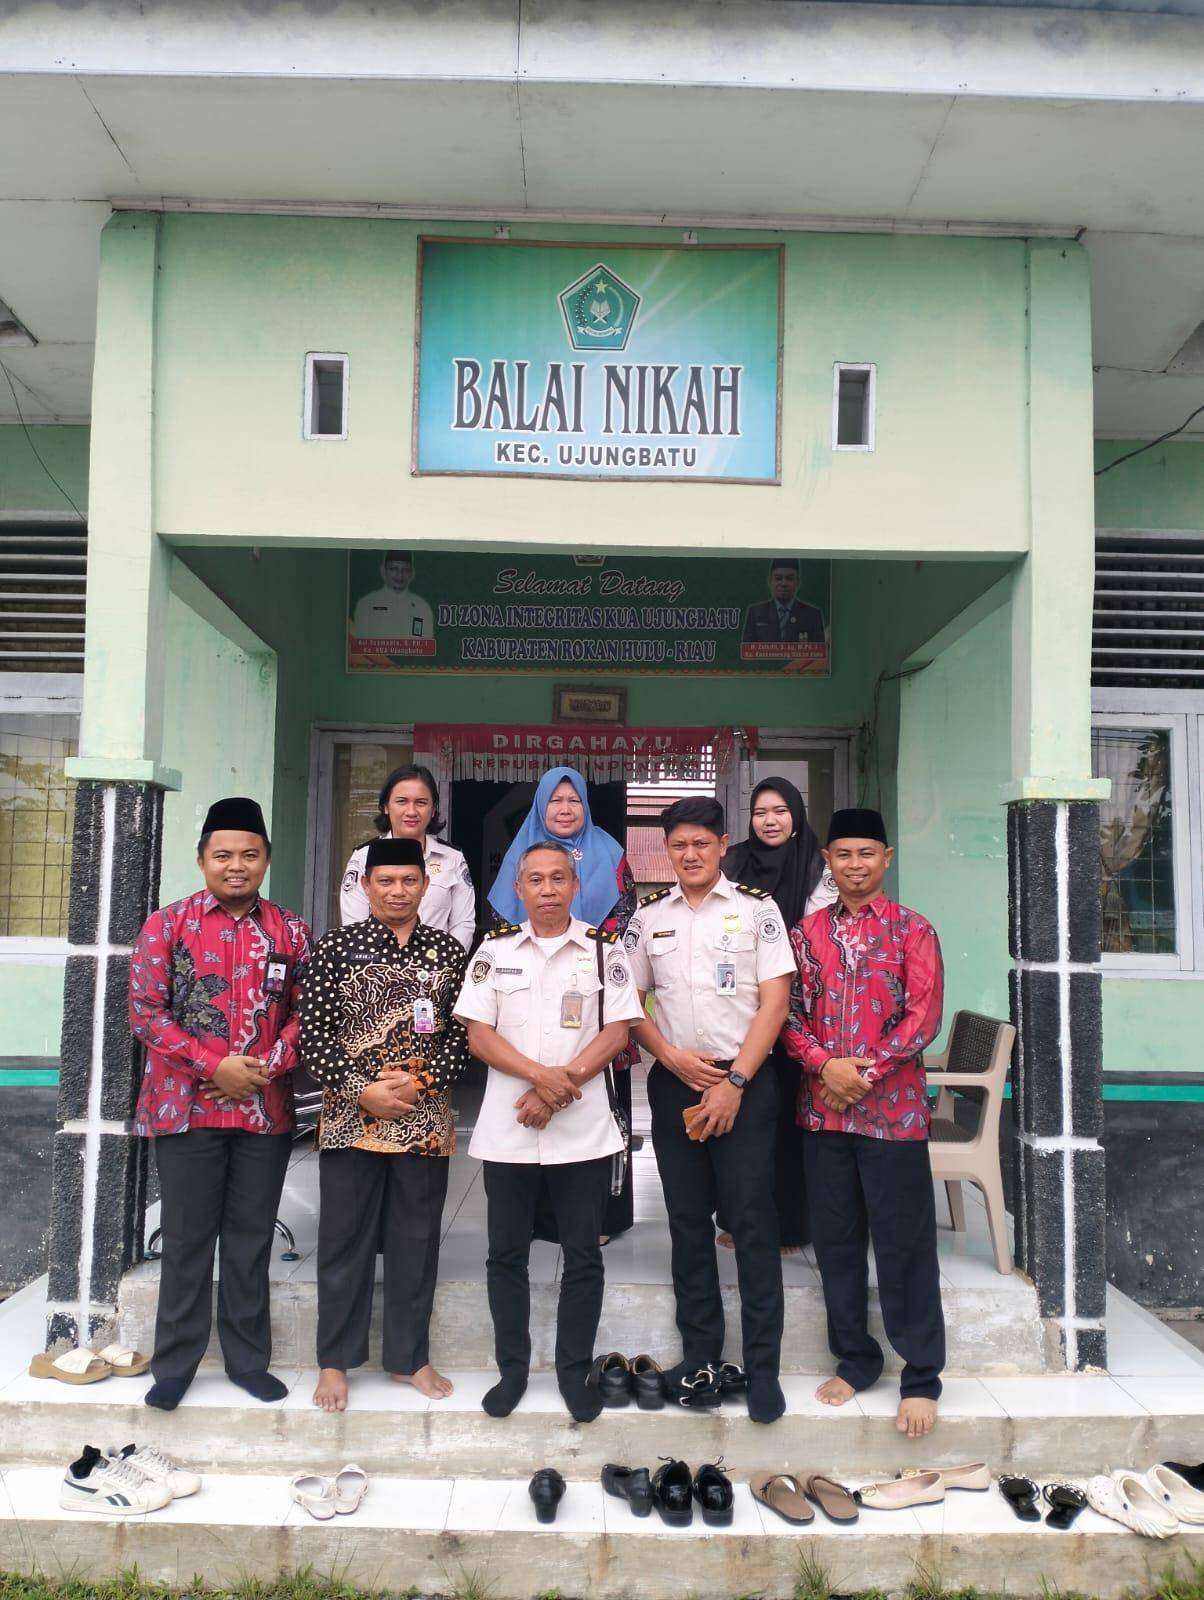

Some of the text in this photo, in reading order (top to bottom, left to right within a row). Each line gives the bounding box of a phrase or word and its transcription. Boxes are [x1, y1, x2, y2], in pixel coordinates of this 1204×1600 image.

[452, 359, 743, 436] BALAI NIKAH
[496, 442, 698, 468] KEC. UJUNGBATU
[493, 568, 686, 602] Selamat Datang
[437, 604, 741, 630] DI ZONA INTEGRITAS KUA UJUNGBATU
[461, 638, 560, 661] KABUPATEN
[561, 639, 620, 662] ROKAN
[620, 640, 667, 662] HULU
[674, 640, 716, 662] RIAU
[492, 734, 672, 750] DIRGAHAYU
